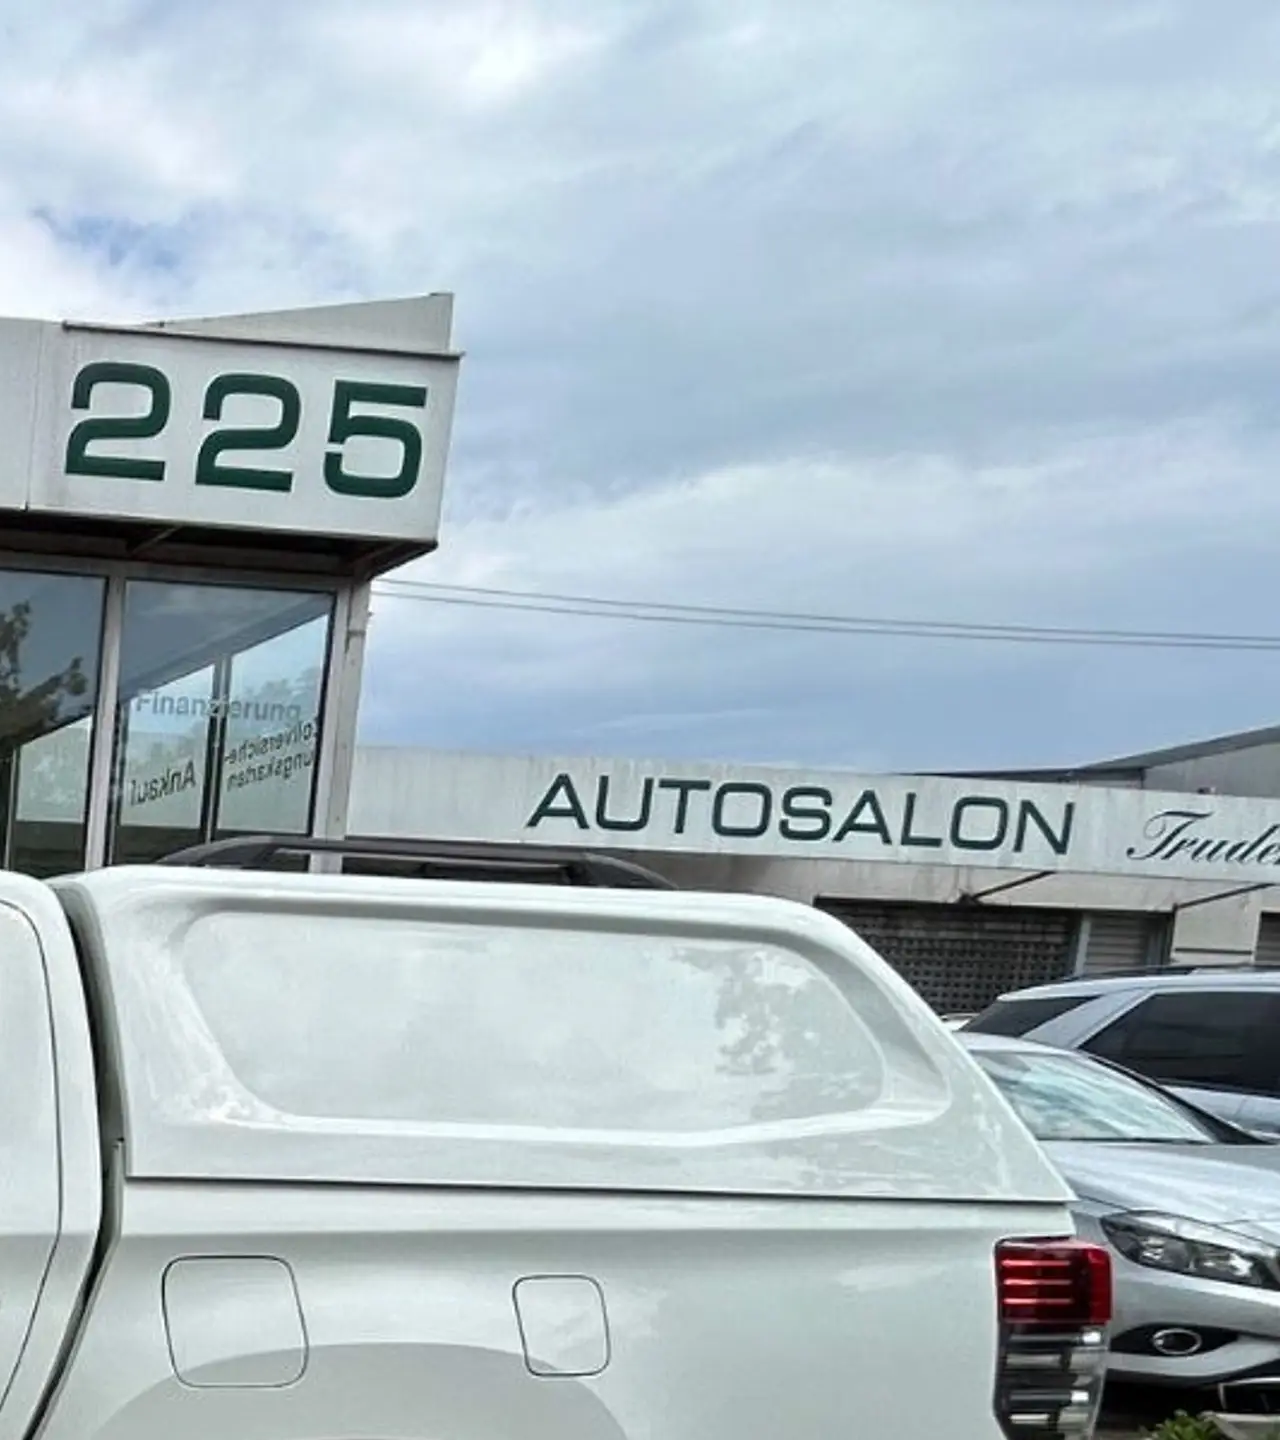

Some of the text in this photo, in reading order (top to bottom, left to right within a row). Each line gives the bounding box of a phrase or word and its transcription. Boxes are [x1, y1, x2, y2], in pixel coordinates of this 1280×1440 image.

[65, 361, 428, 499] 225
[526, 773, 1280, 866] AUTOSALON Trude
